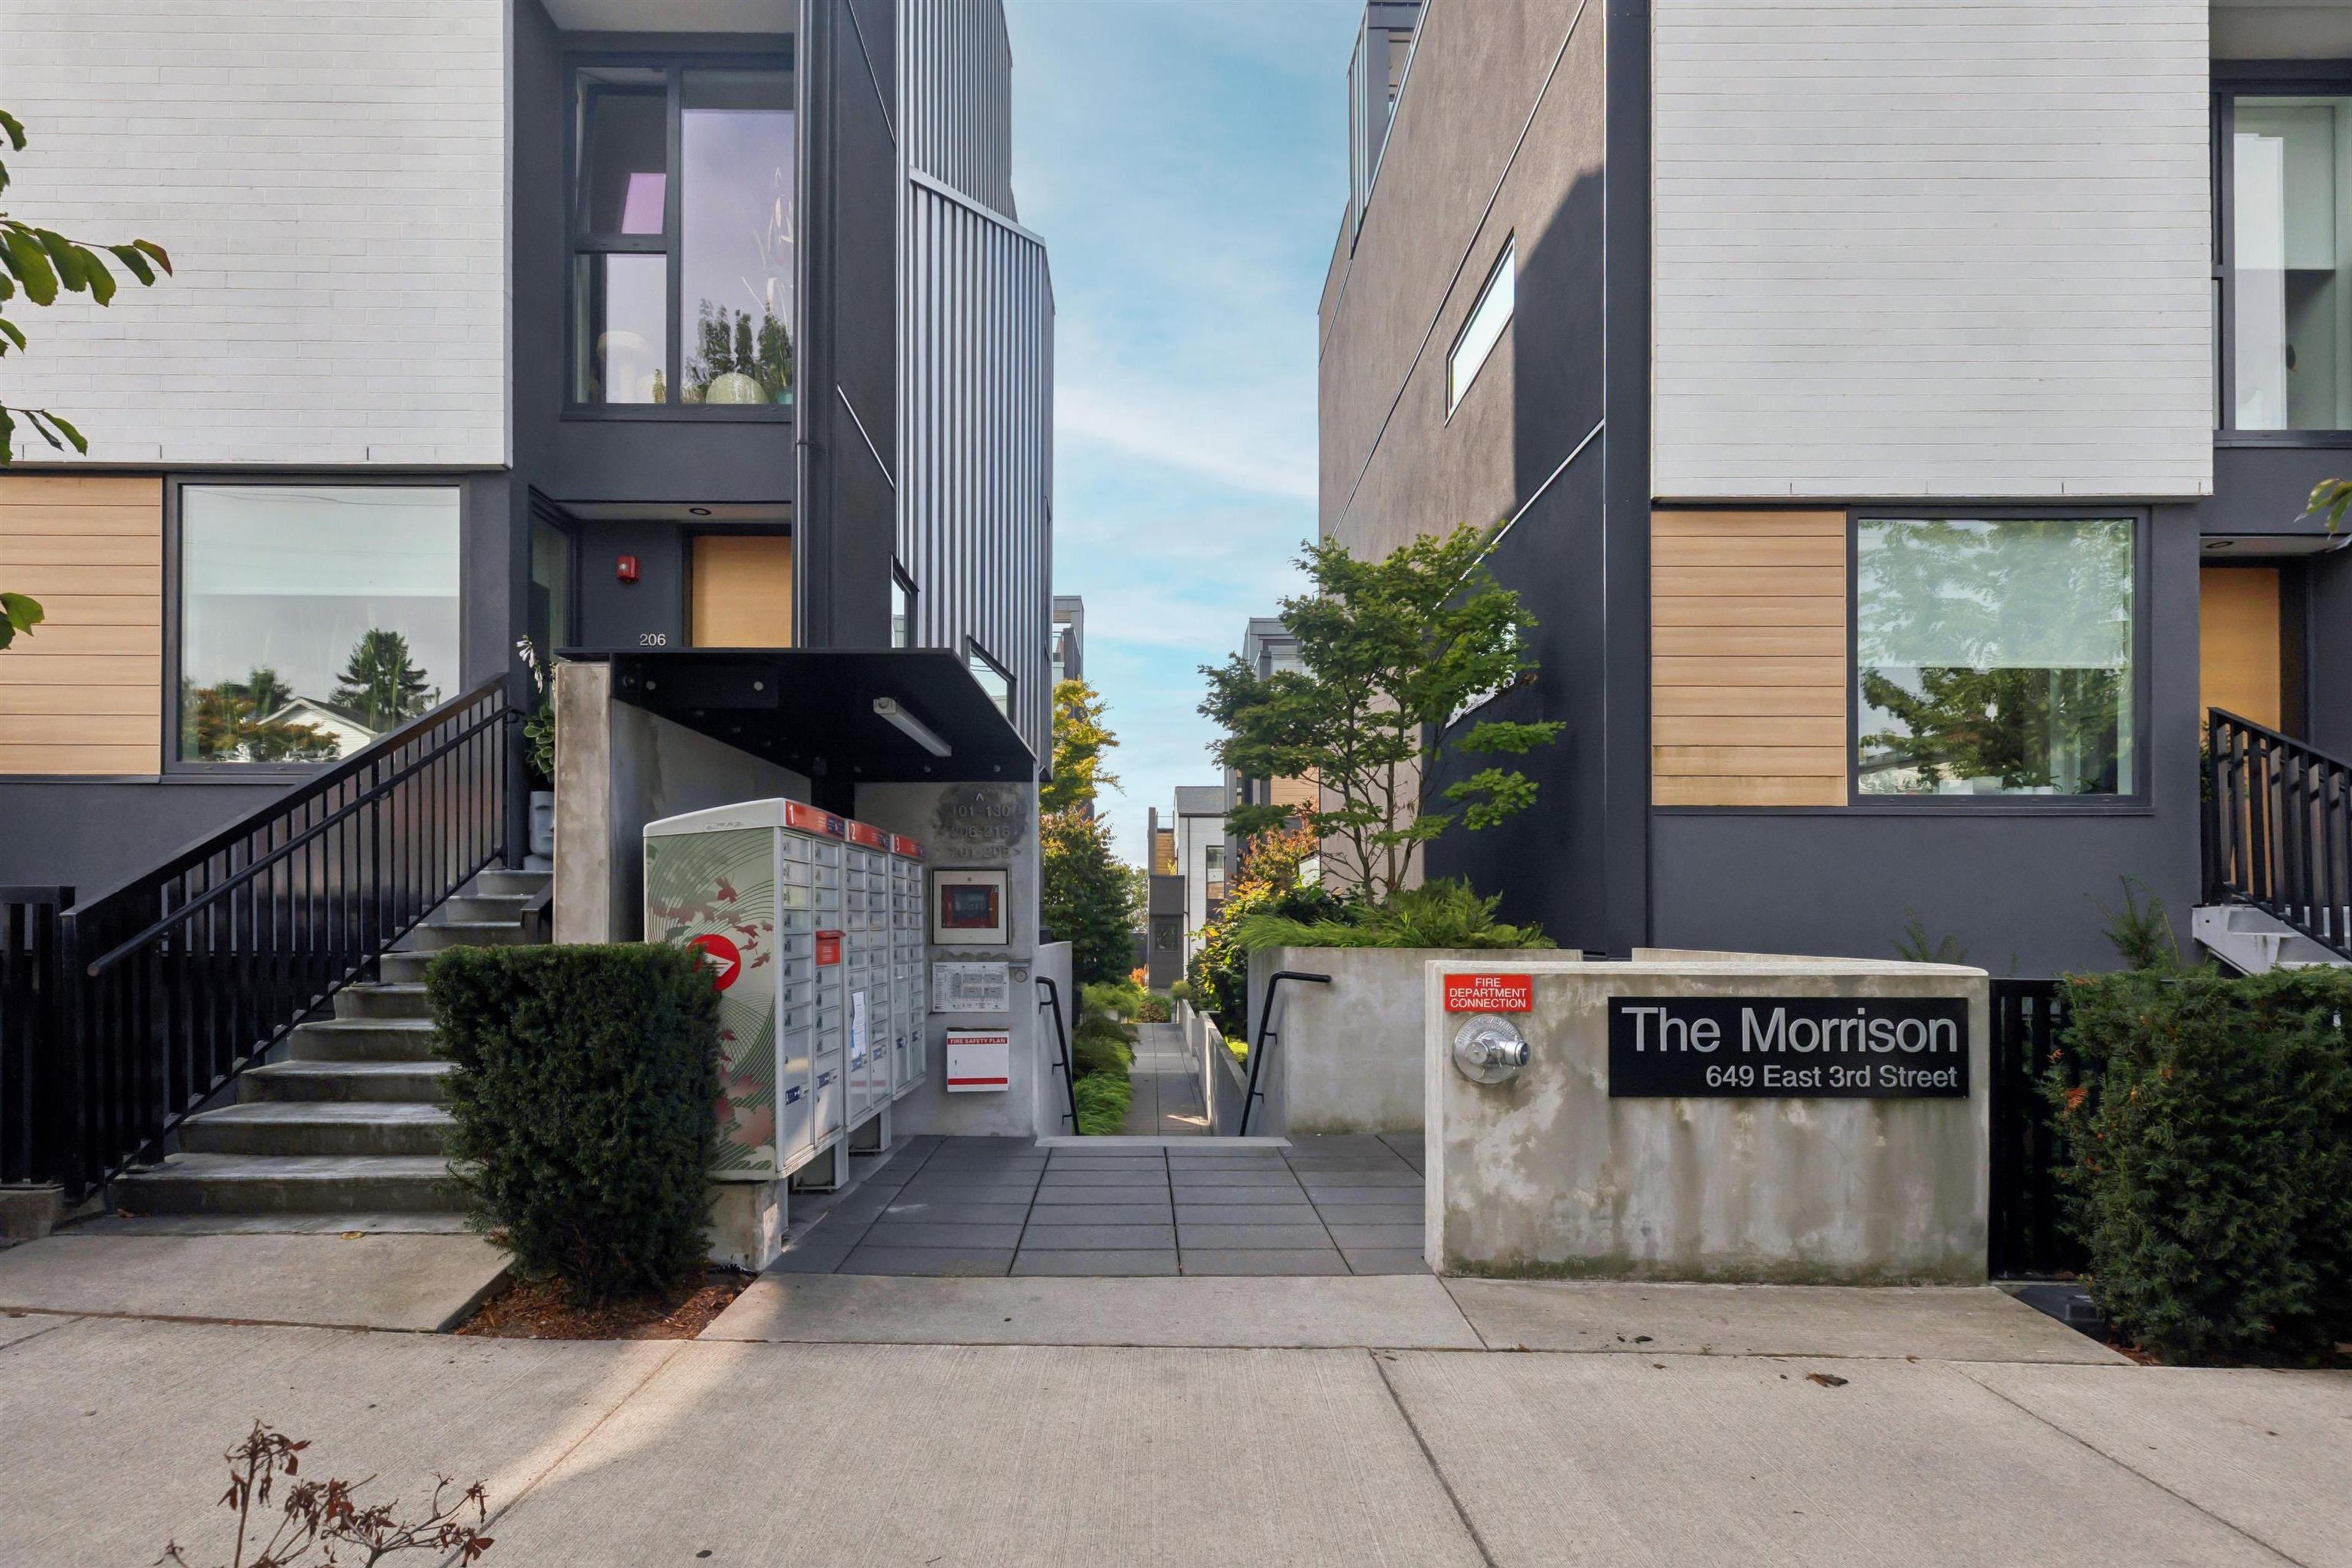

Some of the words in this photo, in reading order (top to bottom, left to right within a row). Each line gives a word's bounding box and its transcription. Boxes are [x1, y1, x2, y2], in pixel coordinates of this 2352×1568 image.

[639, 633, 666, 646] 206
[788, 804, 794, 824] 1
[851, 823, 856, 840] 2
[895, 837, 900, 851] 3
[1475, 978, 1501, 987] FIRE
[1449, 988, 1527, 998] DEPARTMENT
[1450, 998, 1526, 1008] CONNECTION
[1621, 1006, 1721, 1053] The
[1741, 1007, 1958, 1053] Morrison
[1706, 1065, 1755, 1088] 649
[1763, 1065, 1822, 1088] East
[1829, 1065, 1871, 1088] 3rd
[1879, 1064, 1958, 1088] Street
